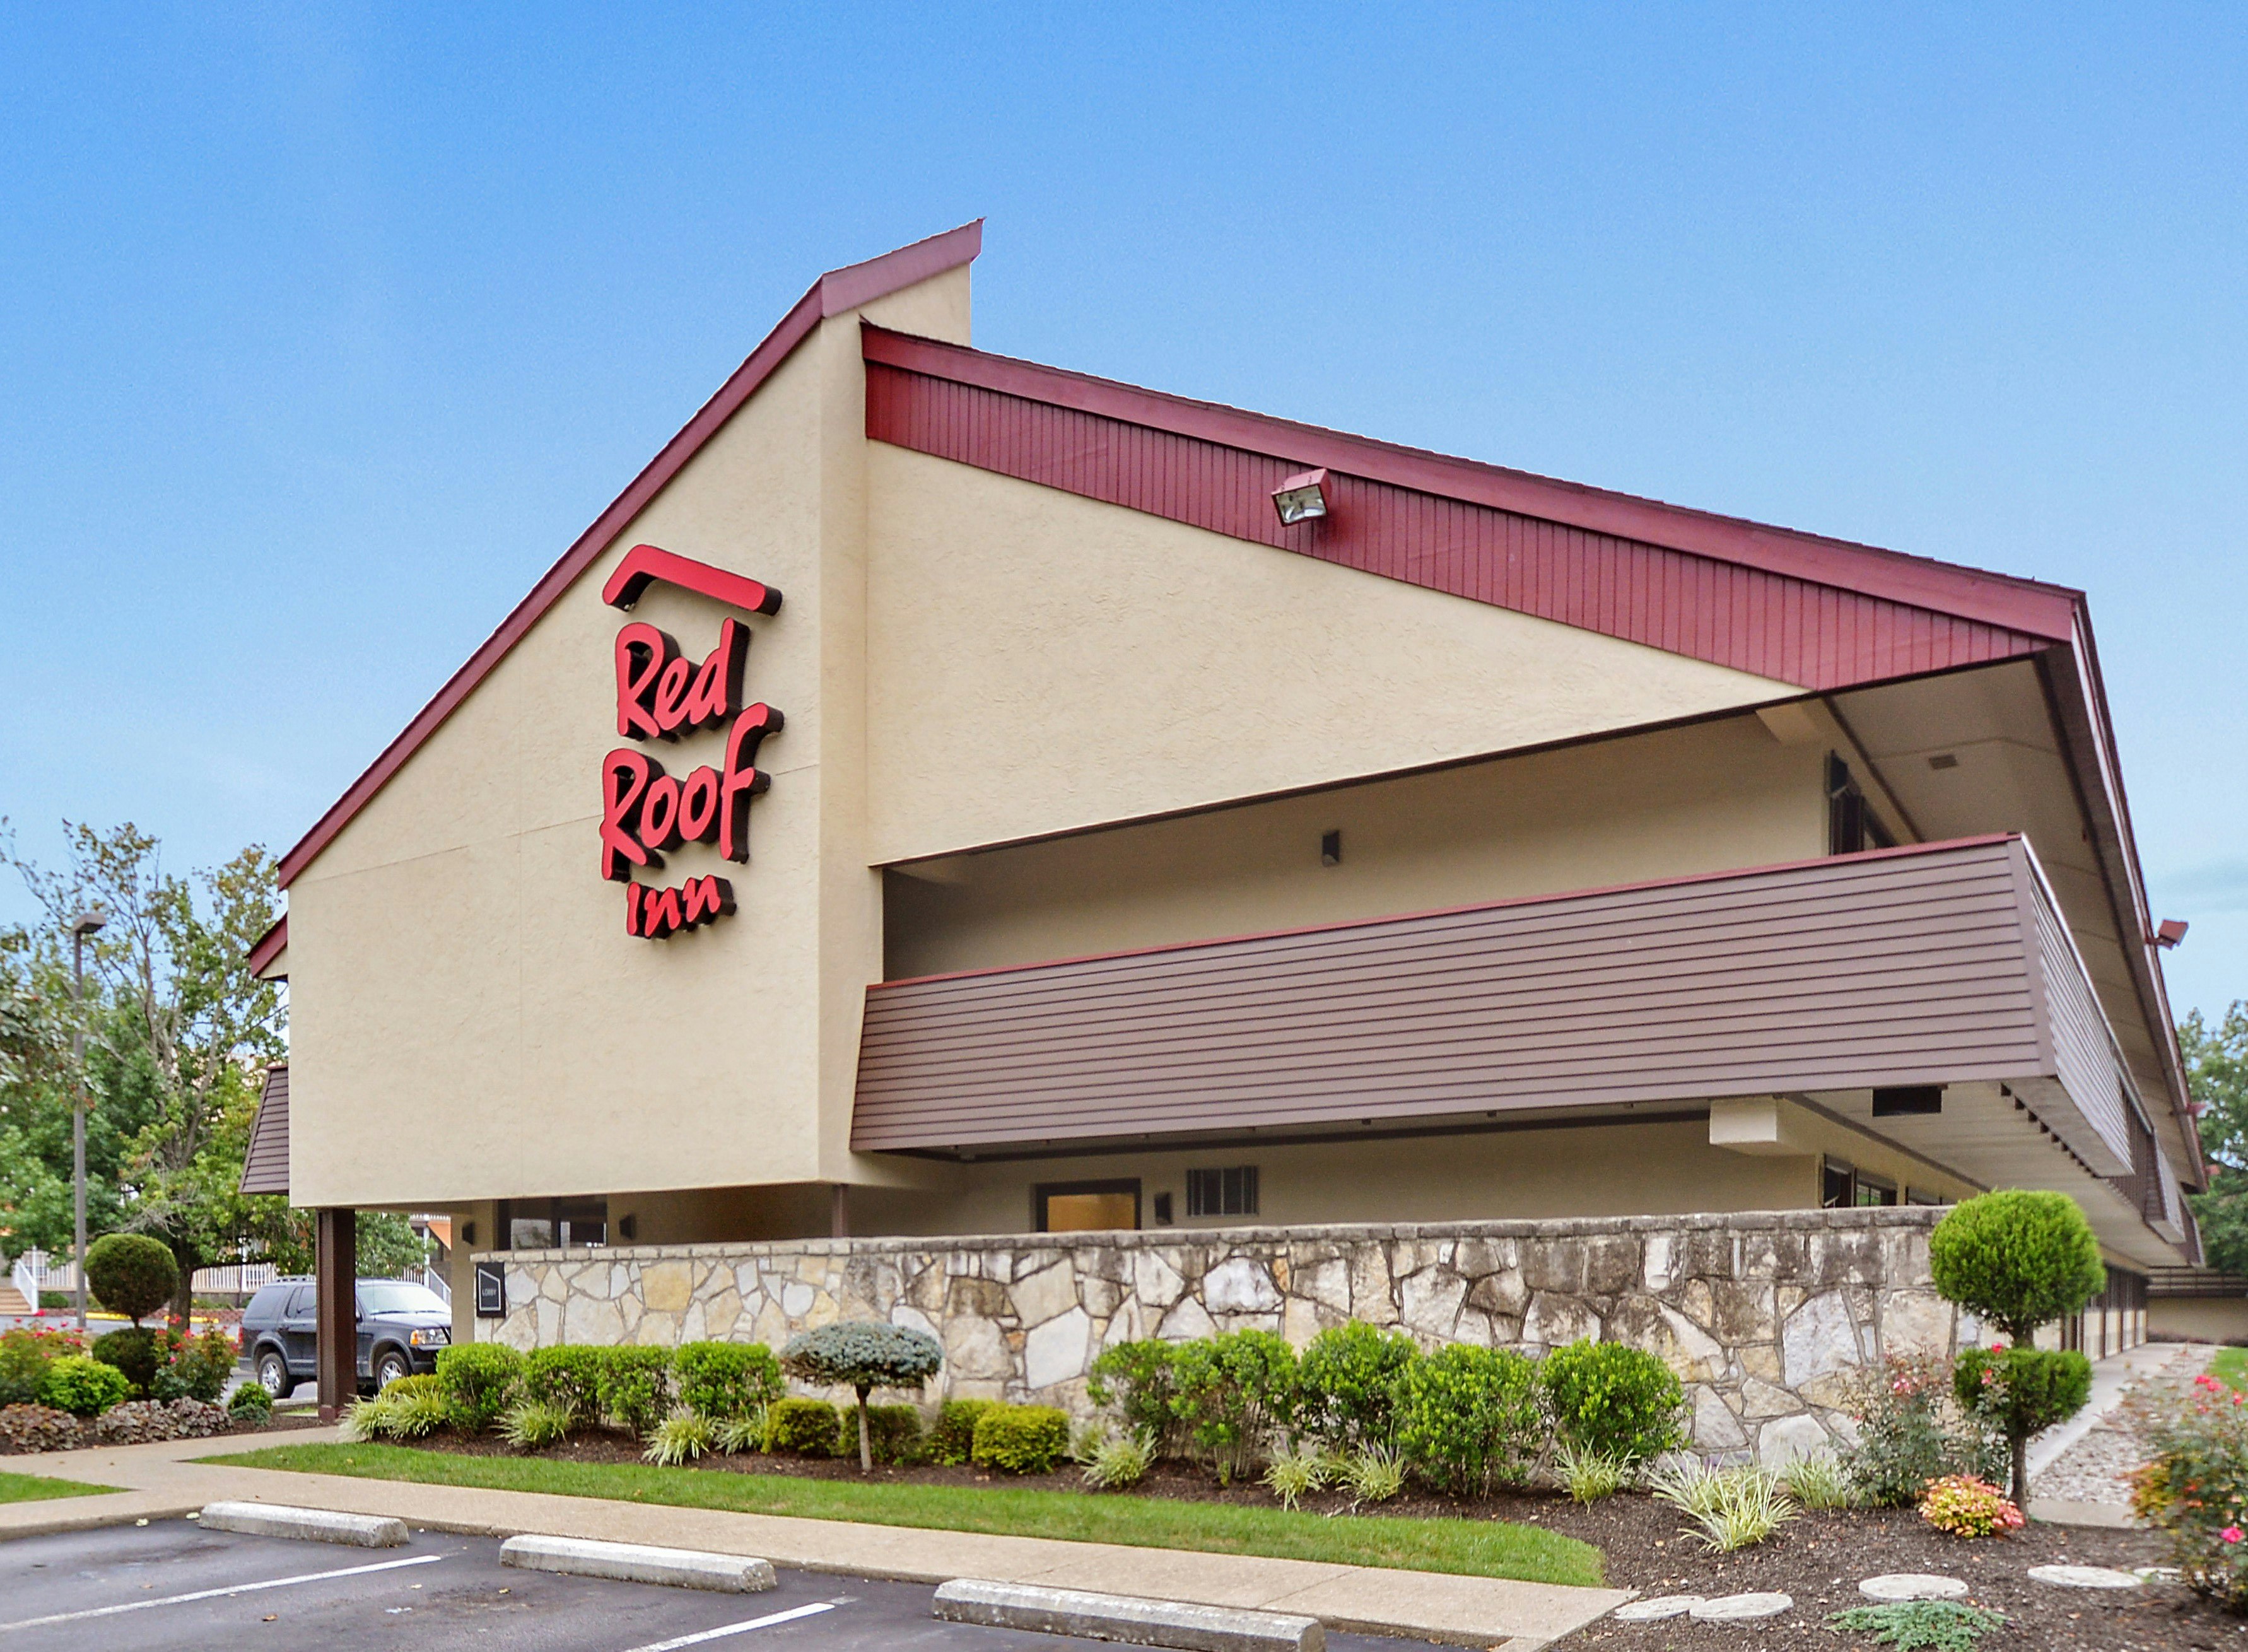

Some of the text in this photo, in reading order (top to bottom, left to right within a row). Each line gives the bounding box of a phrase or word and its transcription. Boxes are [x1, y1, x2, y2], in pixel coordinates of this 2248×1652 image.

[615, 617, 735, 737] Red
[599, 702, 768, 881] Roof
[627, 874, 722, 937] Inn
